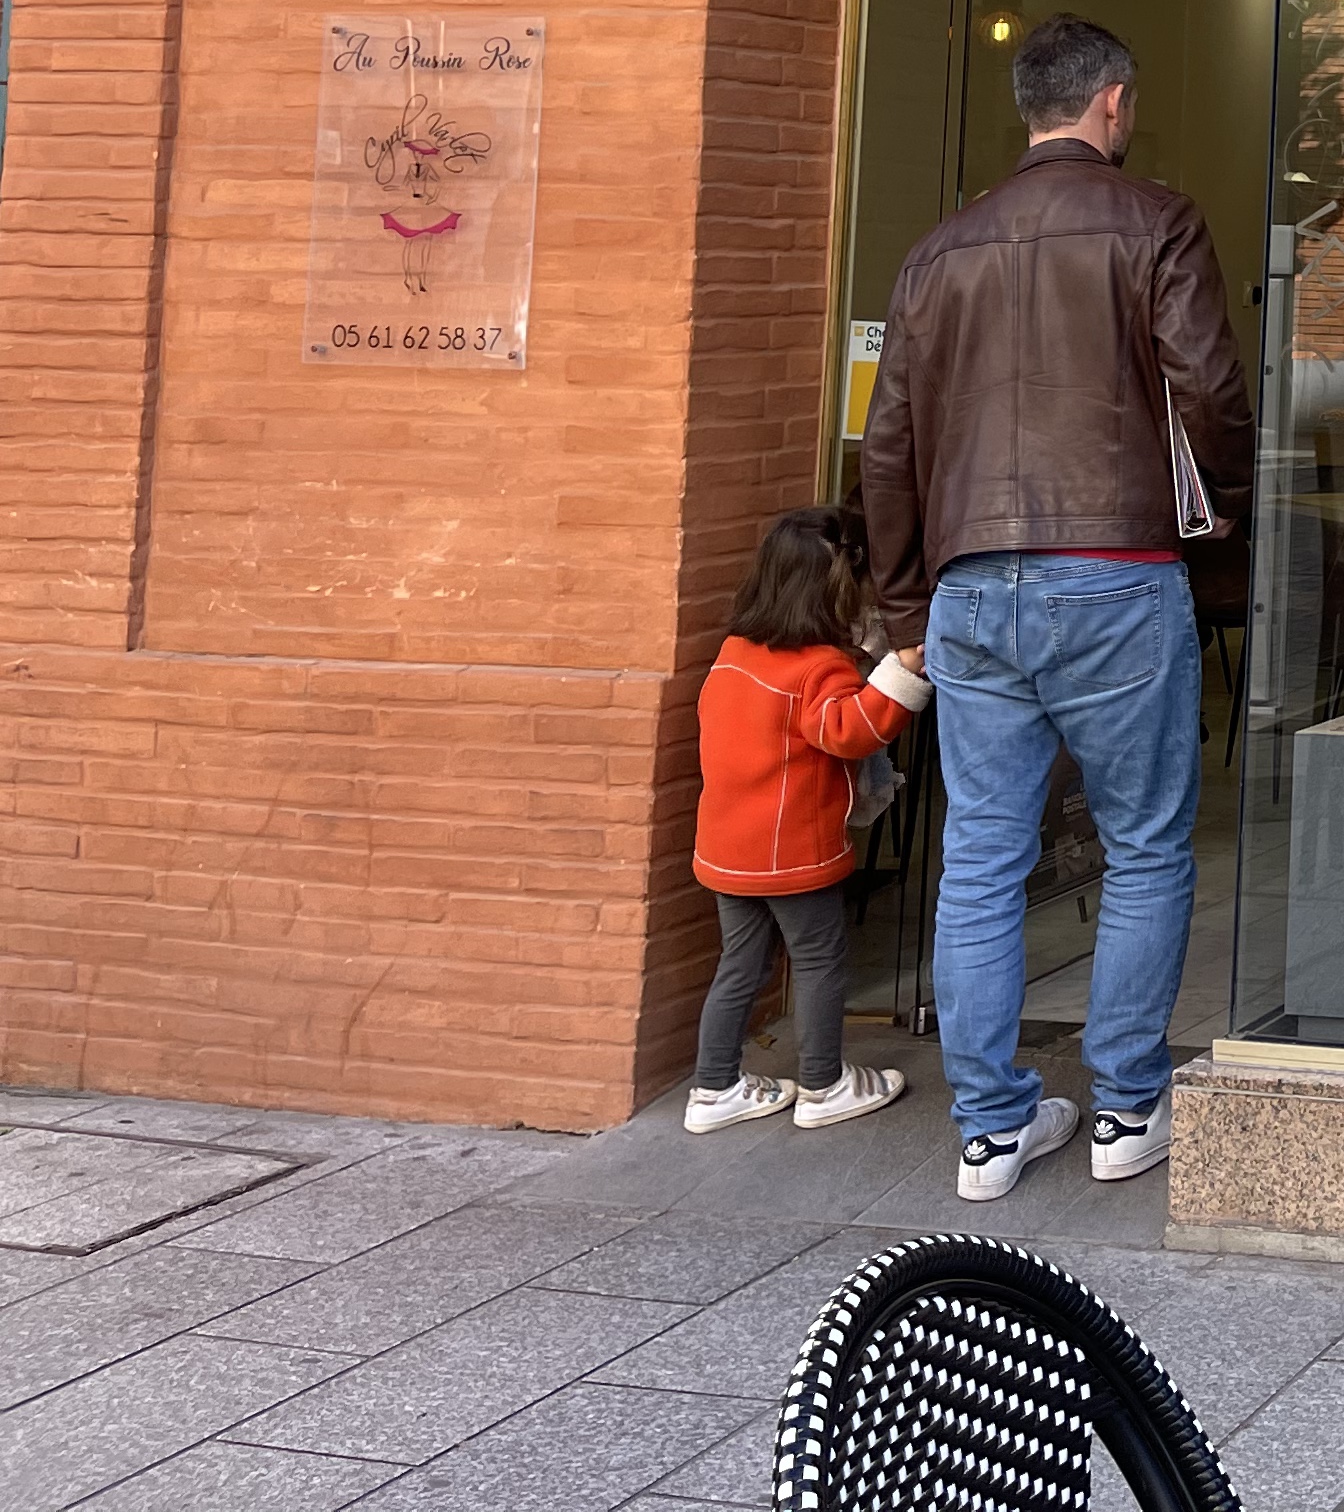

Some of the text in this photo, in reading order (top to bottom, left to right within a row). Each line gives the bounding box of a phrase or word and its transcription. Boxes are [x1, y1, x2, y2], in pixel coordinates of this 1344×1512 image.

[333, 33, 533, 71] Au Poussin Rose
[332, 324, 502, 351] 05 61 62 58 37
[866, 326, 883, 338] Ch
